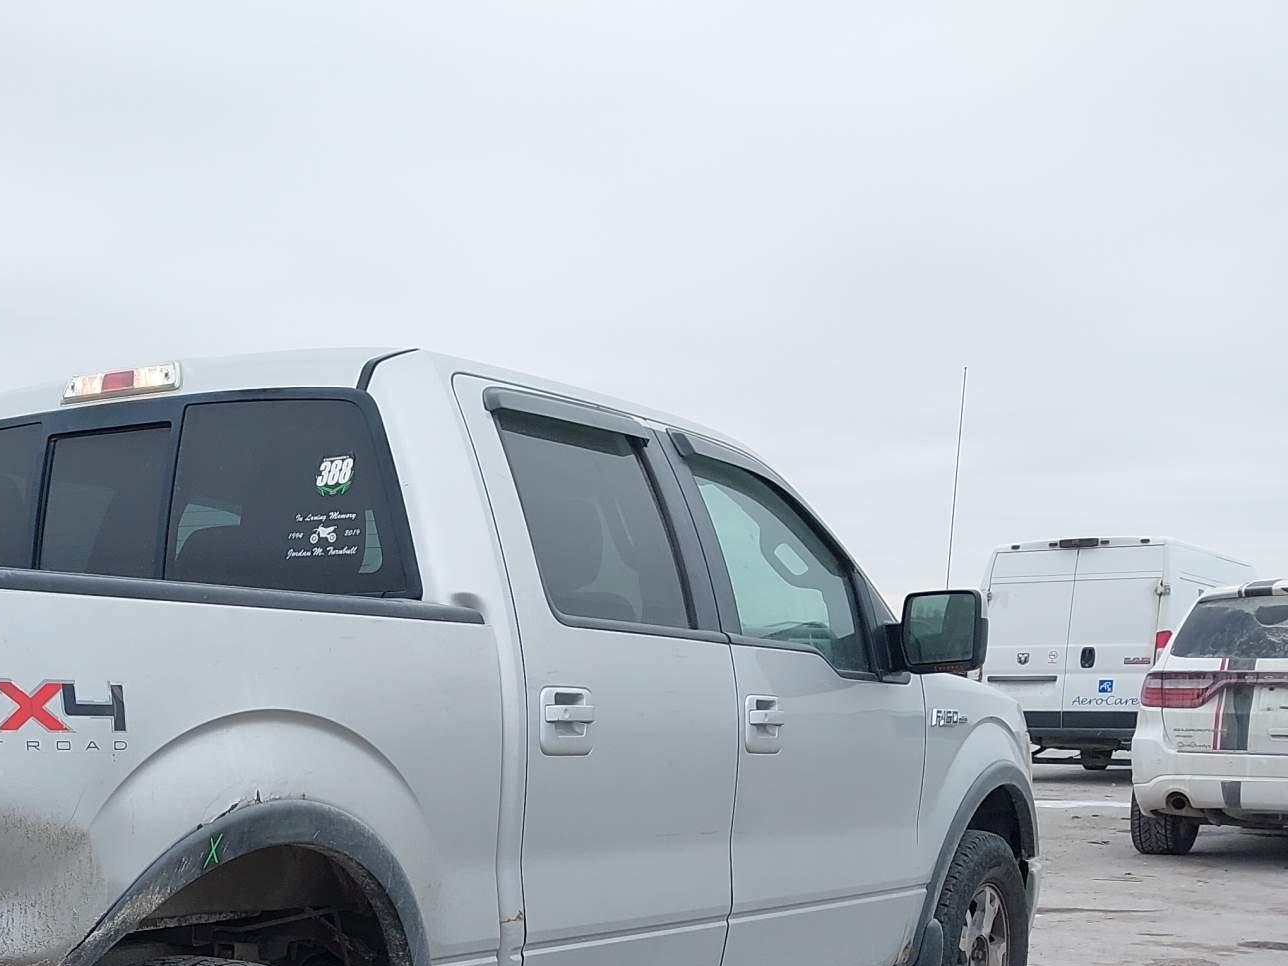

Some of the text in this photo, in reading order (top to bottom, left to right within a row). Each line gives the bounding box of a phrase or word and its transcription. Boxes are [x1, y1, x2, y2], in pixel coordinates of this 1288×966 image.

[316, 458, 354, 487] 388
[328, 511, 357, 521] Memory
[1072, 695, 1140, 706] AeroCare
[25, 740, 128, 752] ROAD
